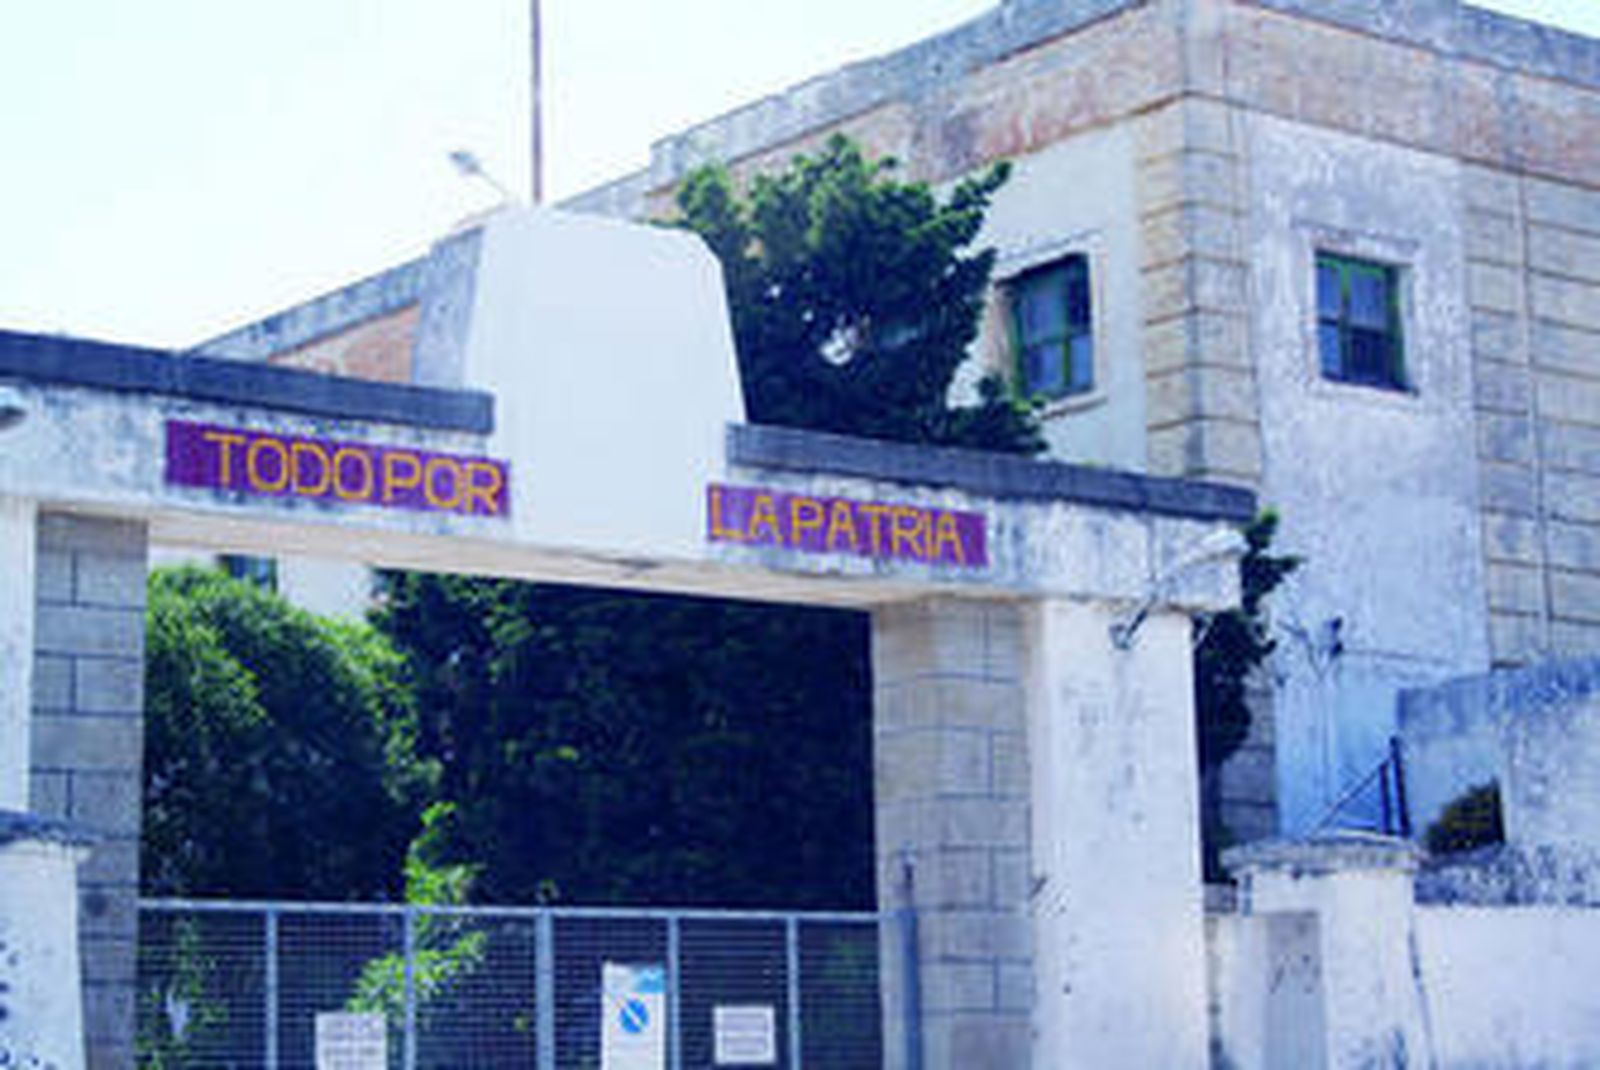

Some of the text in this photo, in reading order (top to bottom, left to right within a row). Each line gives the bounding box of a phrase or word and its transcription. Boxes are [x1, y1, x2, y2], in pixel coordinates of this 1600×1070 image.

[203, 431, 502, 513] TODO POR
[709, 481, 966, 565] LA PATRIA
